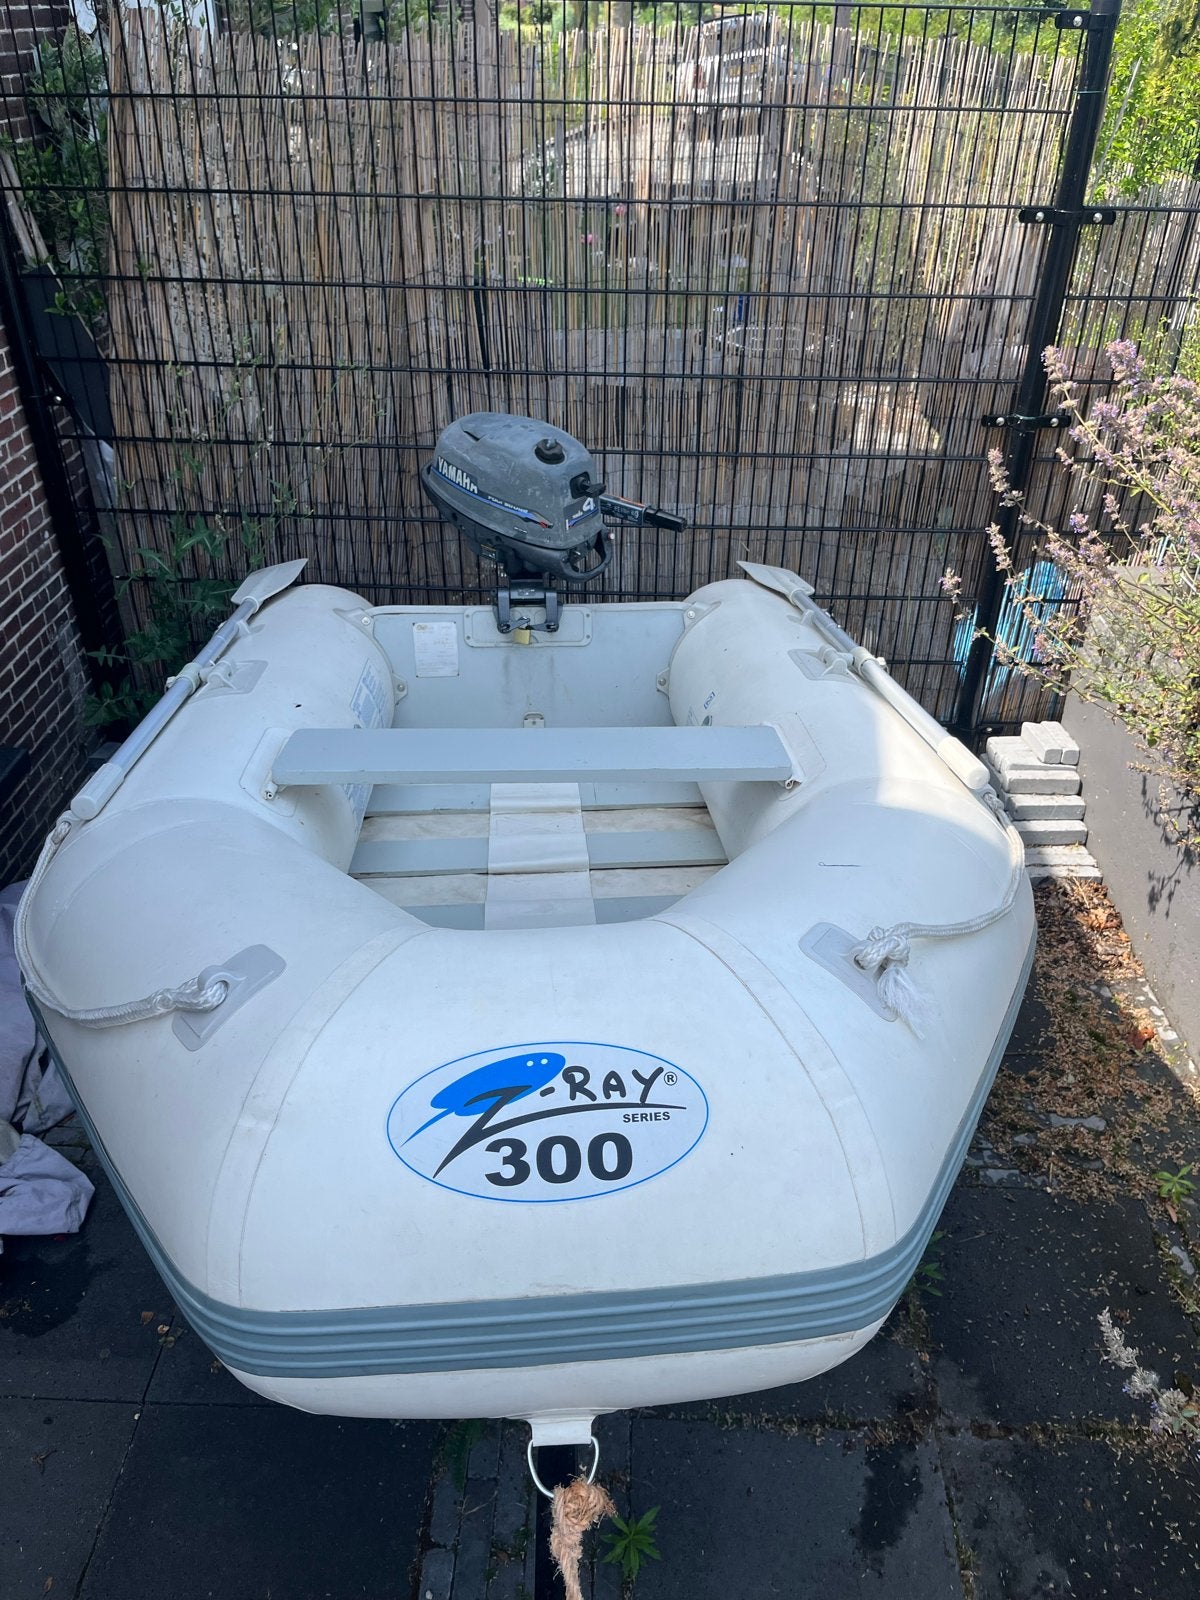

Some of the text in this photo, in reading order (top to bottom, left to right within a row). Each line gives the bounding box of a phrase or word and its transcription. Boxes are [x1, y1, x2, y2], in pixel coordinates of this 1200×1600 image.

[582, 497, 596, 511] 4
[622, 1111, 670, 1123] SERIES
[484, 1132, 633, 1187] 300
